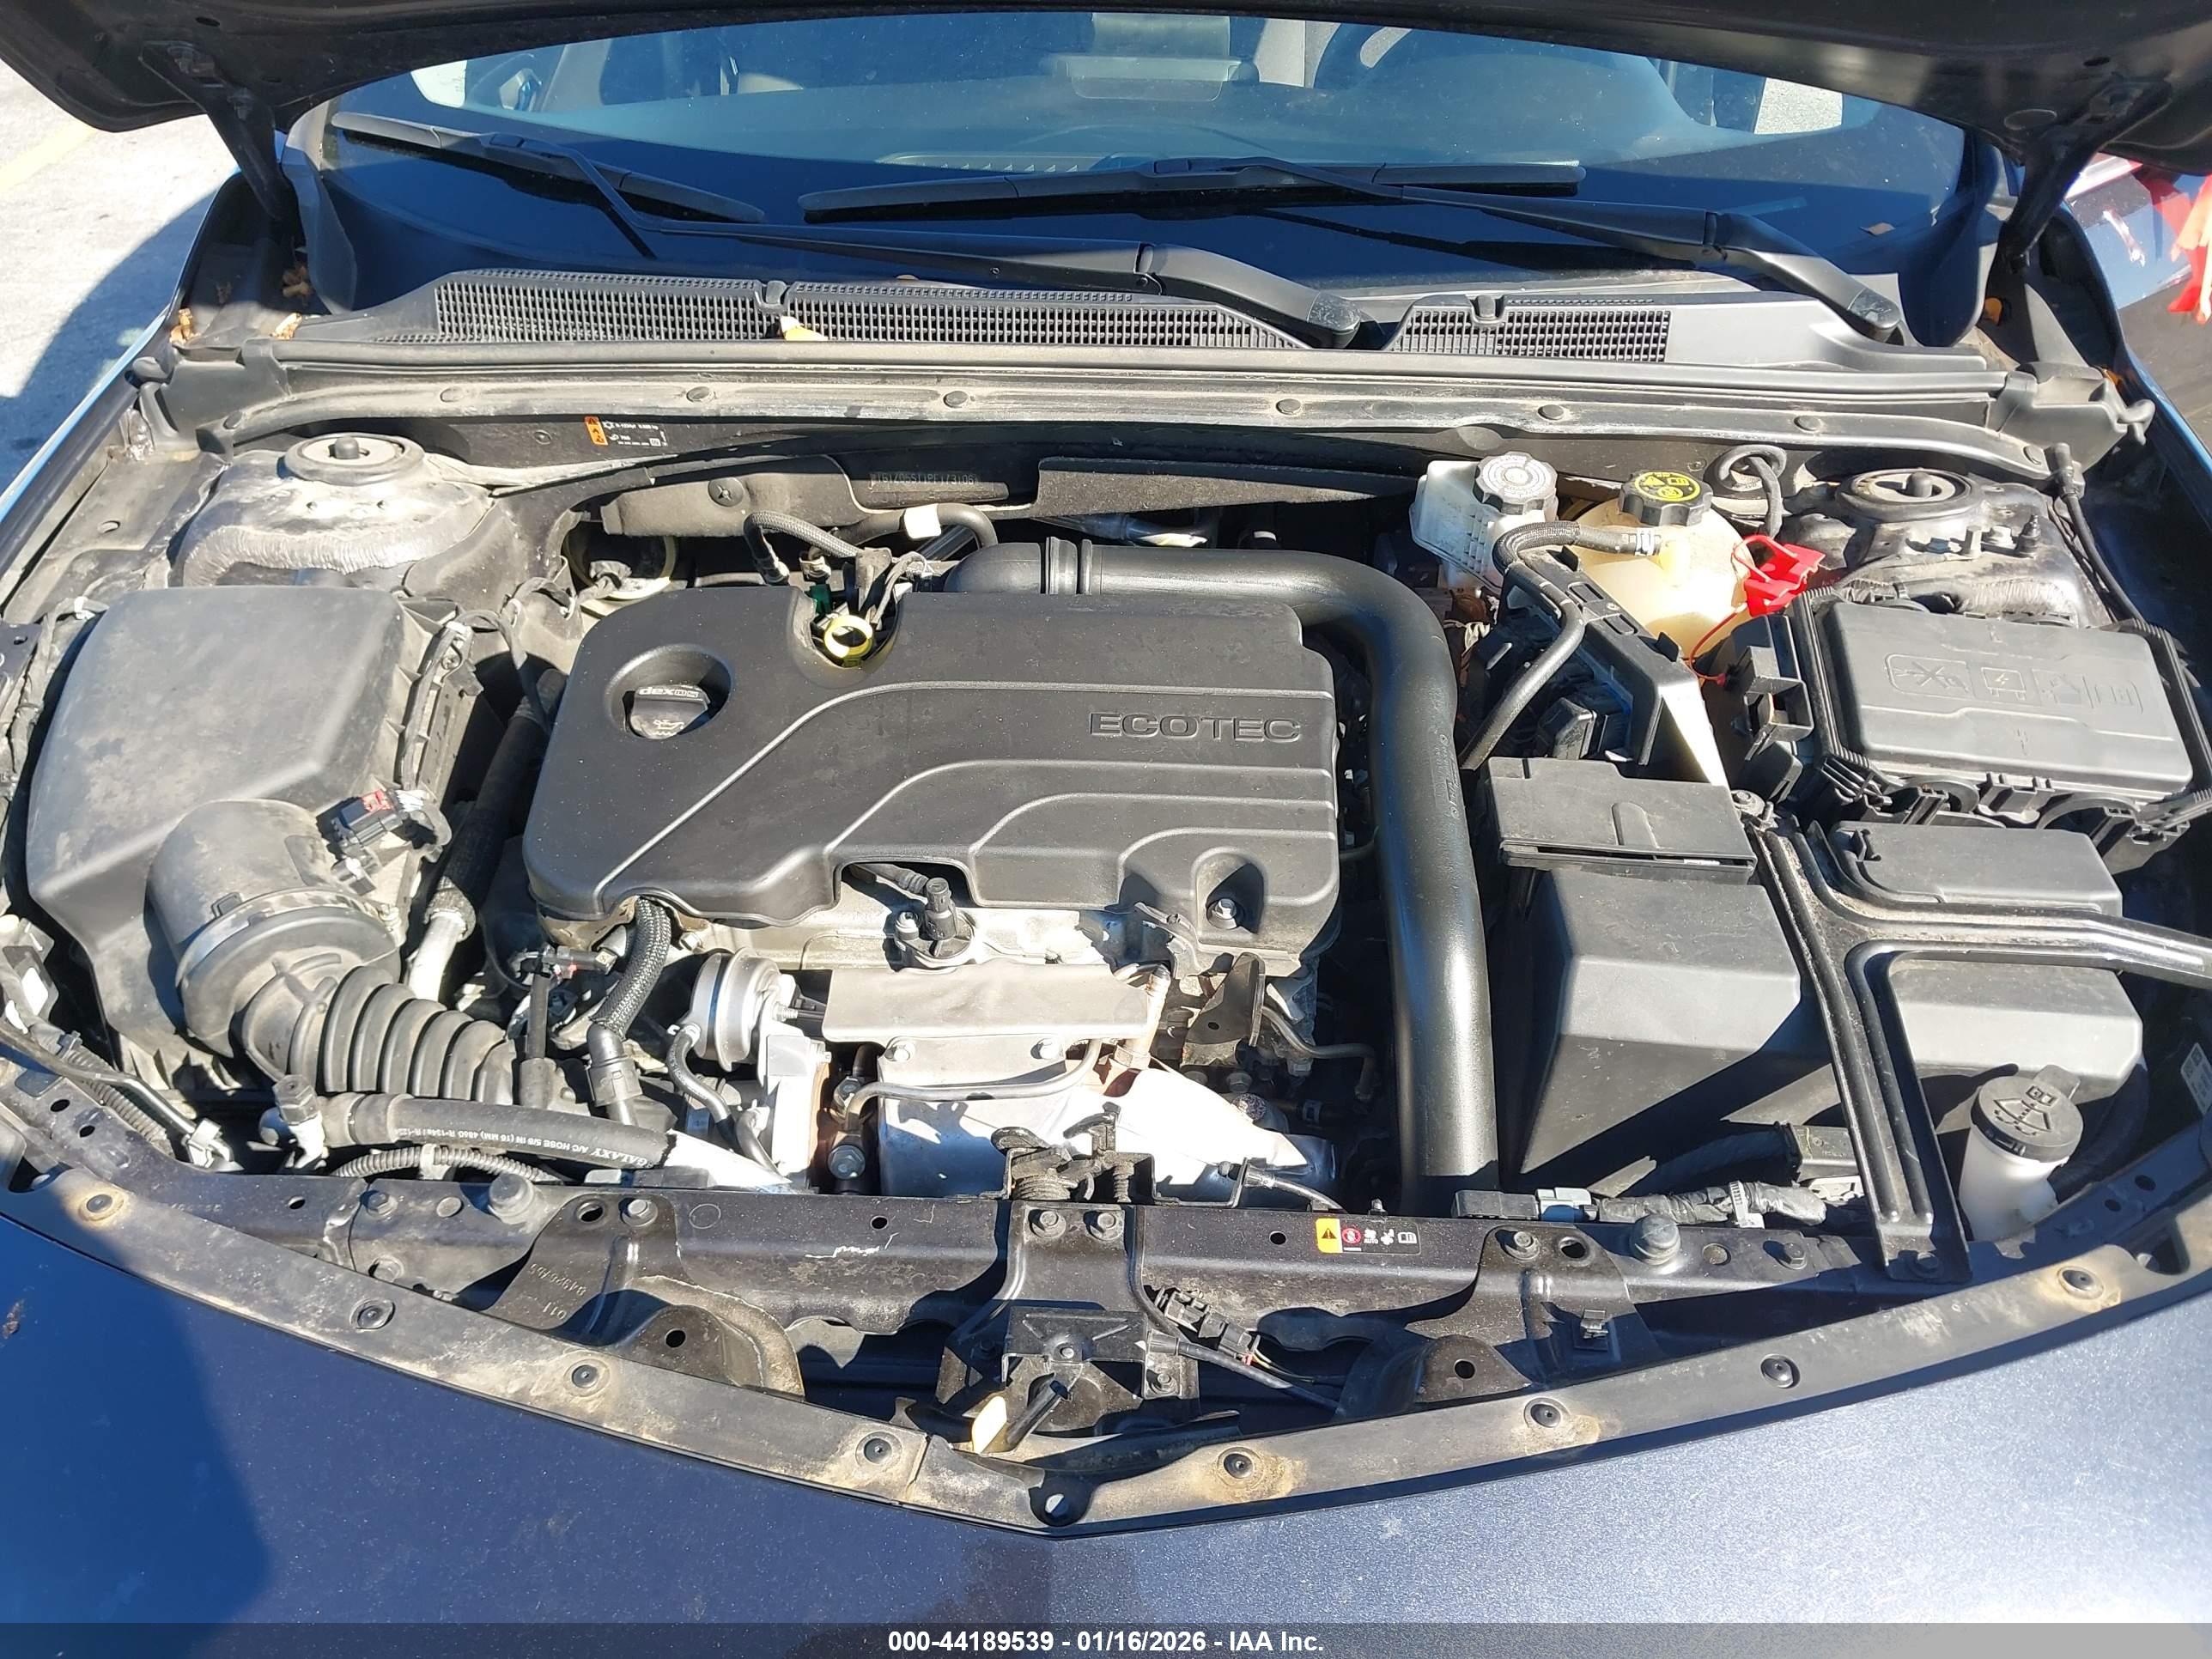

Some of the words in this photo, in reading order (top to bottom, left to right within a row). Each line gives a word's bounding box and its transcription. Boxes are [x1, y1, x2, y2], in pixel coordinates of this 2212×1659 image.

[639, 687, 700, 698] dexos
[1090, 712, 1301, 743] ECOTEC
[543, 1140, 570, 1151] HOSE
[591, 1147, 648, 1167] GALAXY
